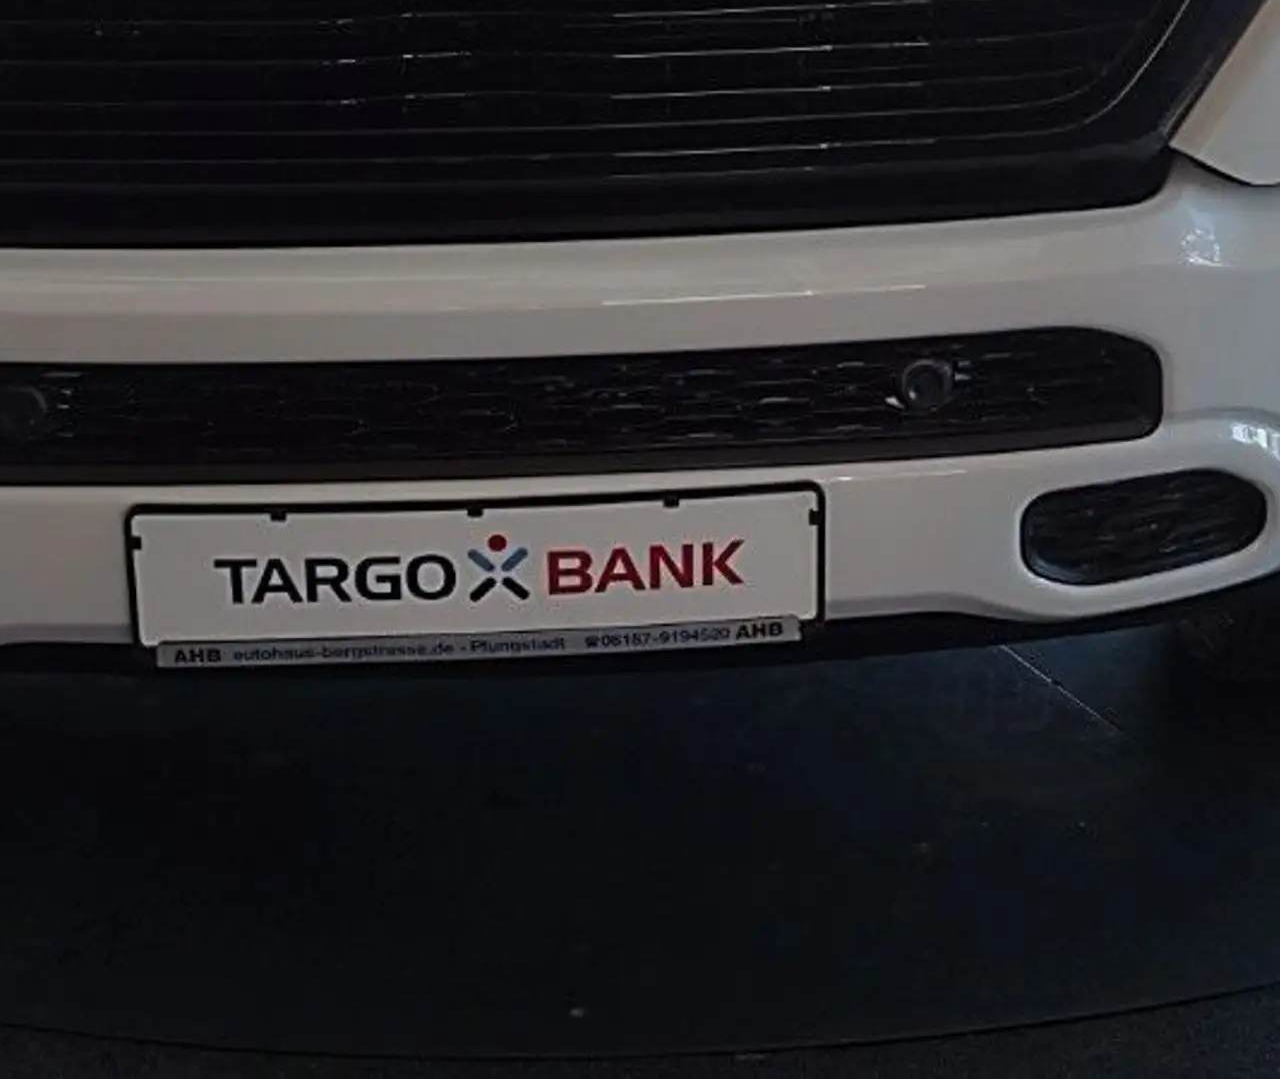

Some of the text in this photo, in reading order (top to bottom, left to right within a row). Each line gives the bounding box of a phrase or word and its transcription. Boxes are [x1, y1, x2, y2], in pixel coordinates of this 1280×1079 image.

[214, 538, 746, 605] TARGO BANK
[174, 648, 222, 664] AHB
[735, 621, 785, 640] AHB
